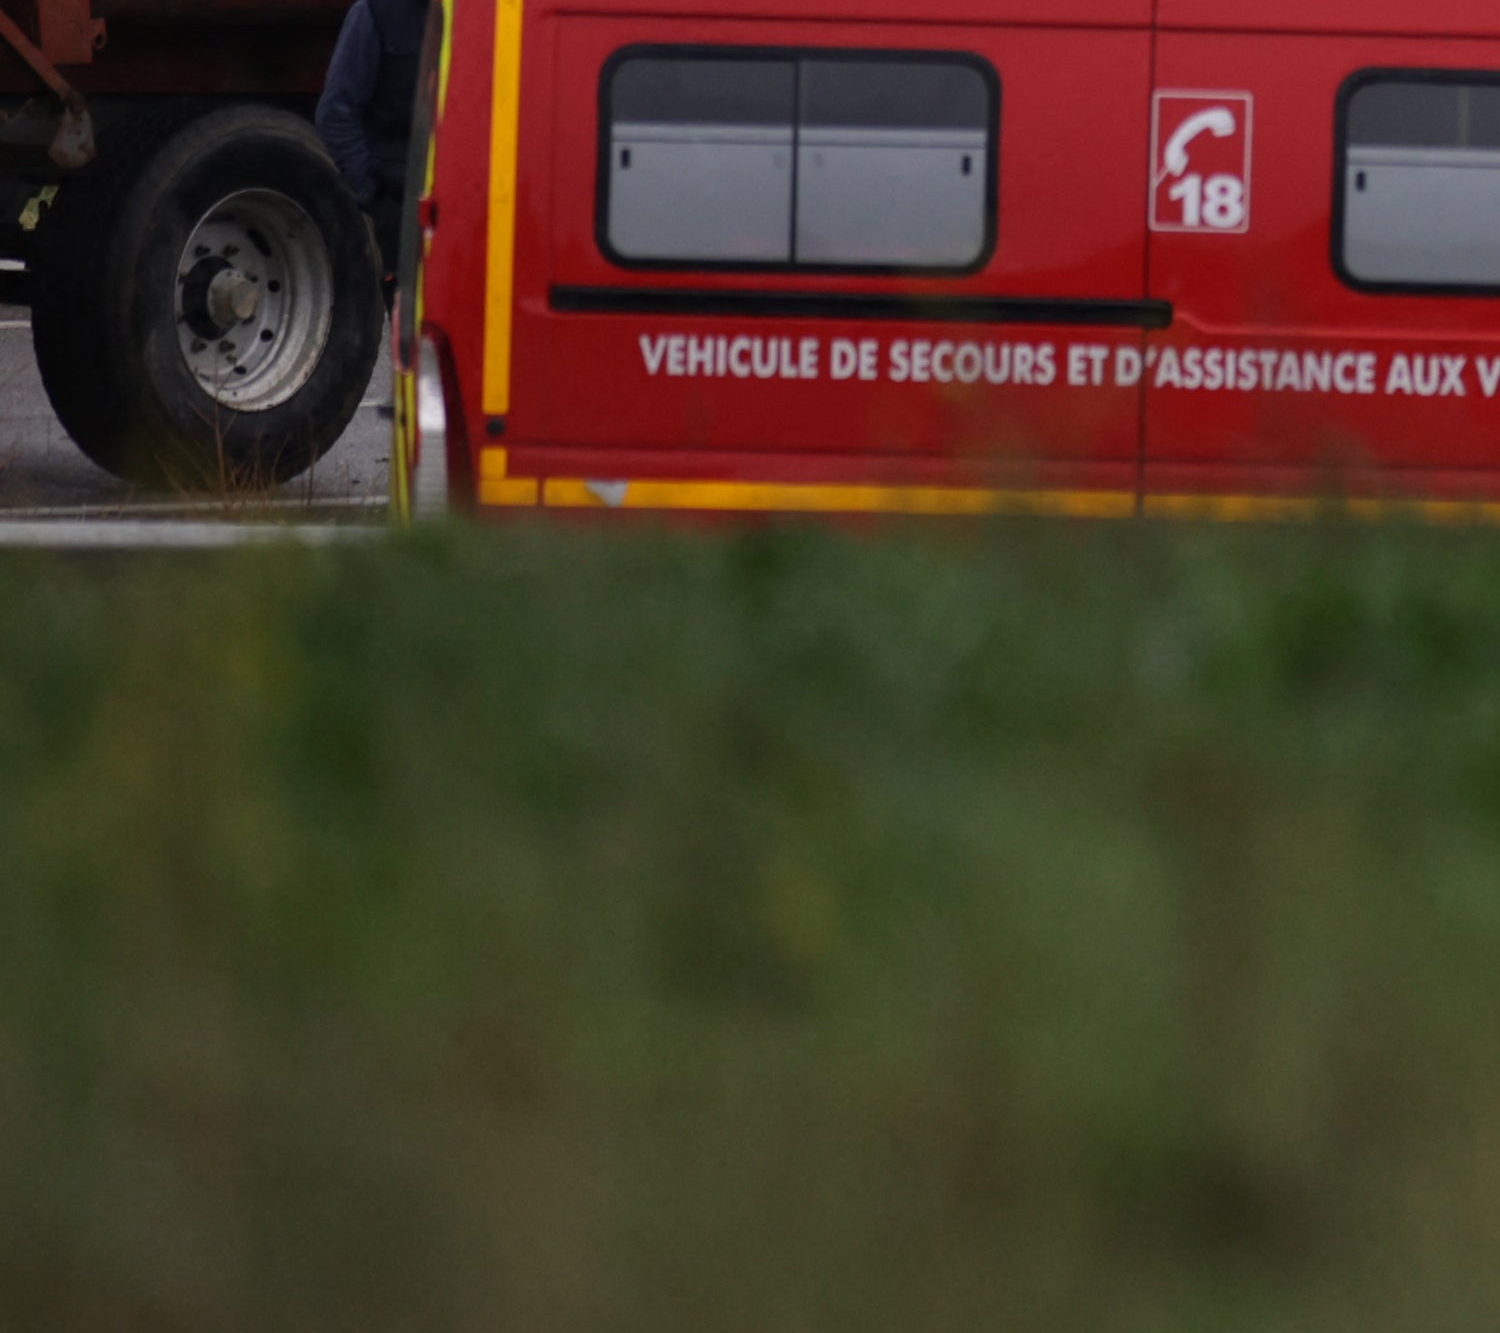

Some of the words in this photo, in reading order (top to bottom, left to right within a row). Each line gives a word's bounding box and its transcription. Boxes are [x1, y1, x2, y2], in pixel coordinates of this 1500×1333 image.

[1168, 172, 1244, 229] 18
[638, 333, 819, 380] VEHICULE
[829, 337, 878, 382] DE
[888, 340, 1056, 386] SECOURS
[1067, 343, 1108, 387] ET
[1114, 345, 1376, 395] D'ASSISTANCE
[1385, 353, 1466, 398] AUX
